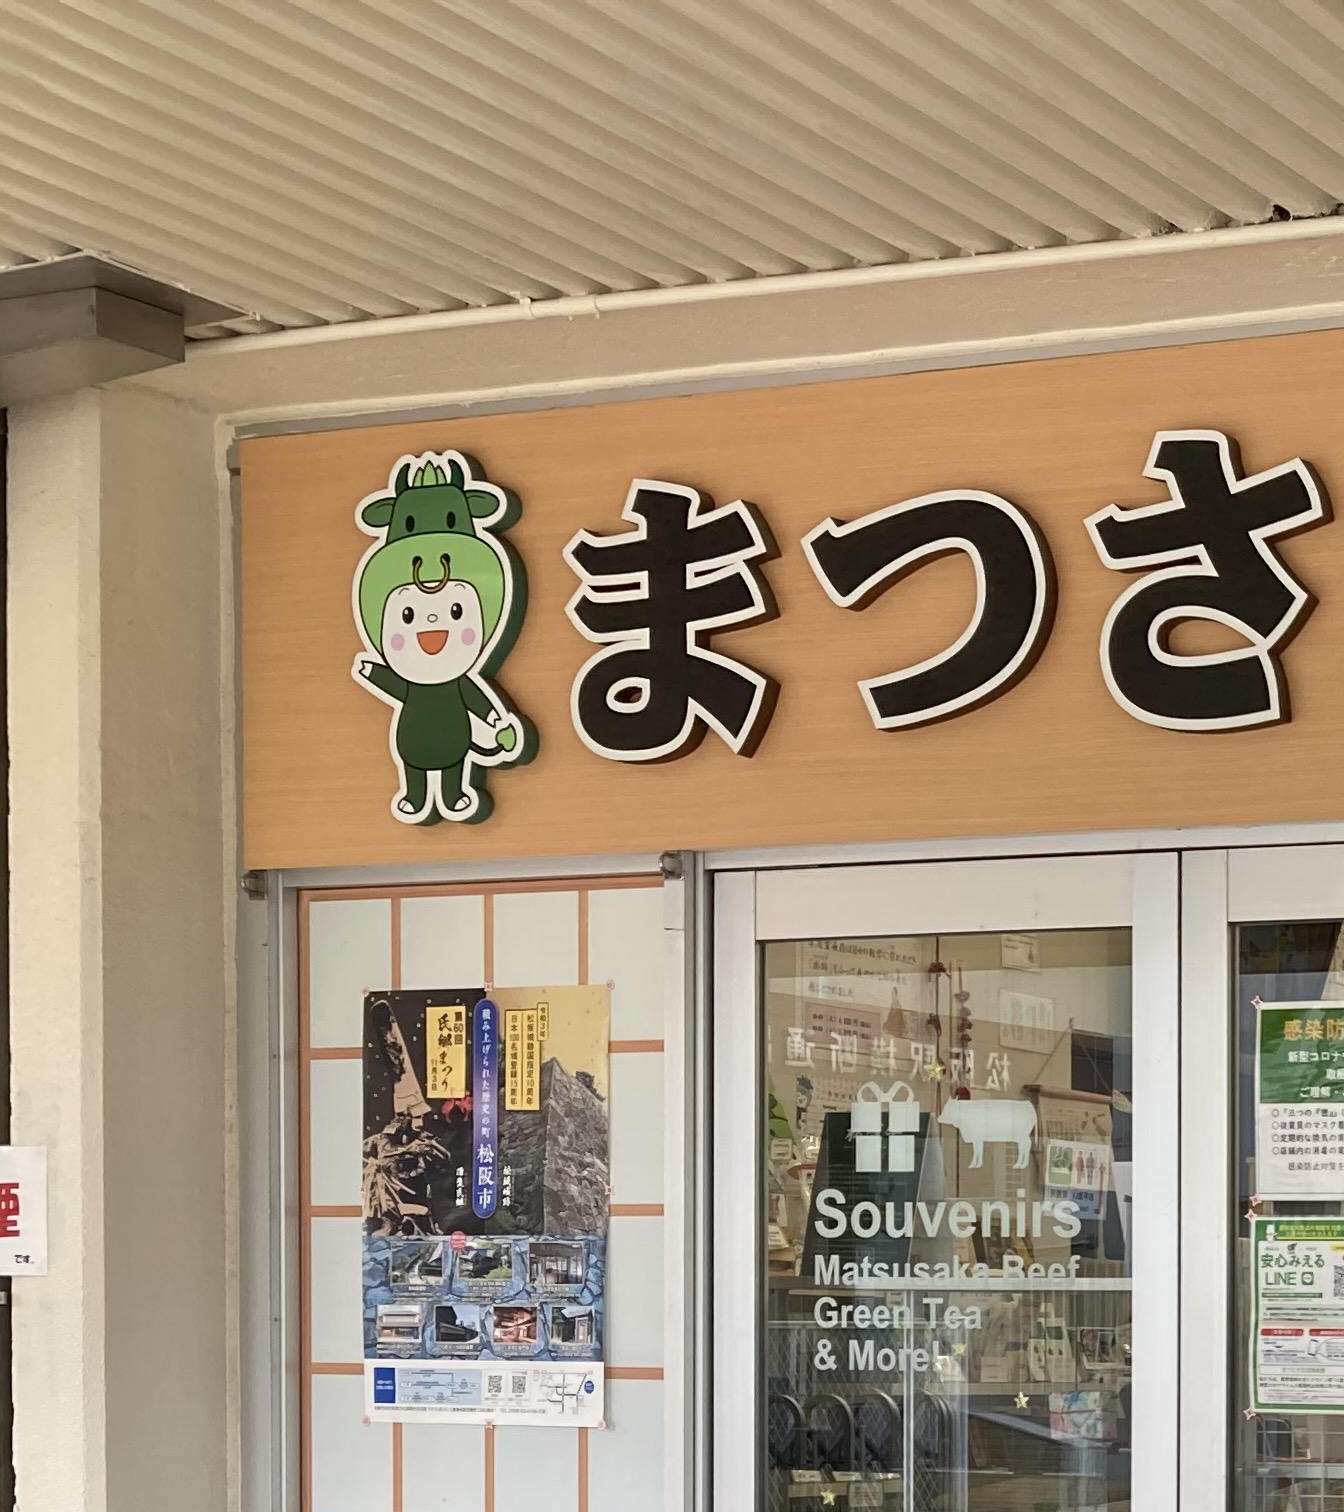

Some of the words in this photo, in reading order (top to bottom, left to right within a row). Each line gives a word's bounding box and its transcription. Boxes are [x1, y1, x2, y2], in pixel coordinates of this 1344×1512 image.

[453, 1011, 464, 1046] 第60回
[476, 1143, 495, 1209] 松阪市
[813, 1188, 1083, 1239] Souvenirs
[813, 1254, 991, 1287] Matsusaka
[1001, 1254, 1082, 1283] Beef
[1260, 1253, 1326, 1269] 安心みえる
[1264, 1271, 1298, 1286] LINE
[813, 1296, 913, 1330] Green
[922, 1296, 983, 1330] Tea
[813, 1338, 838, 1372] &
[848, 1338, 941, 1372] More!
